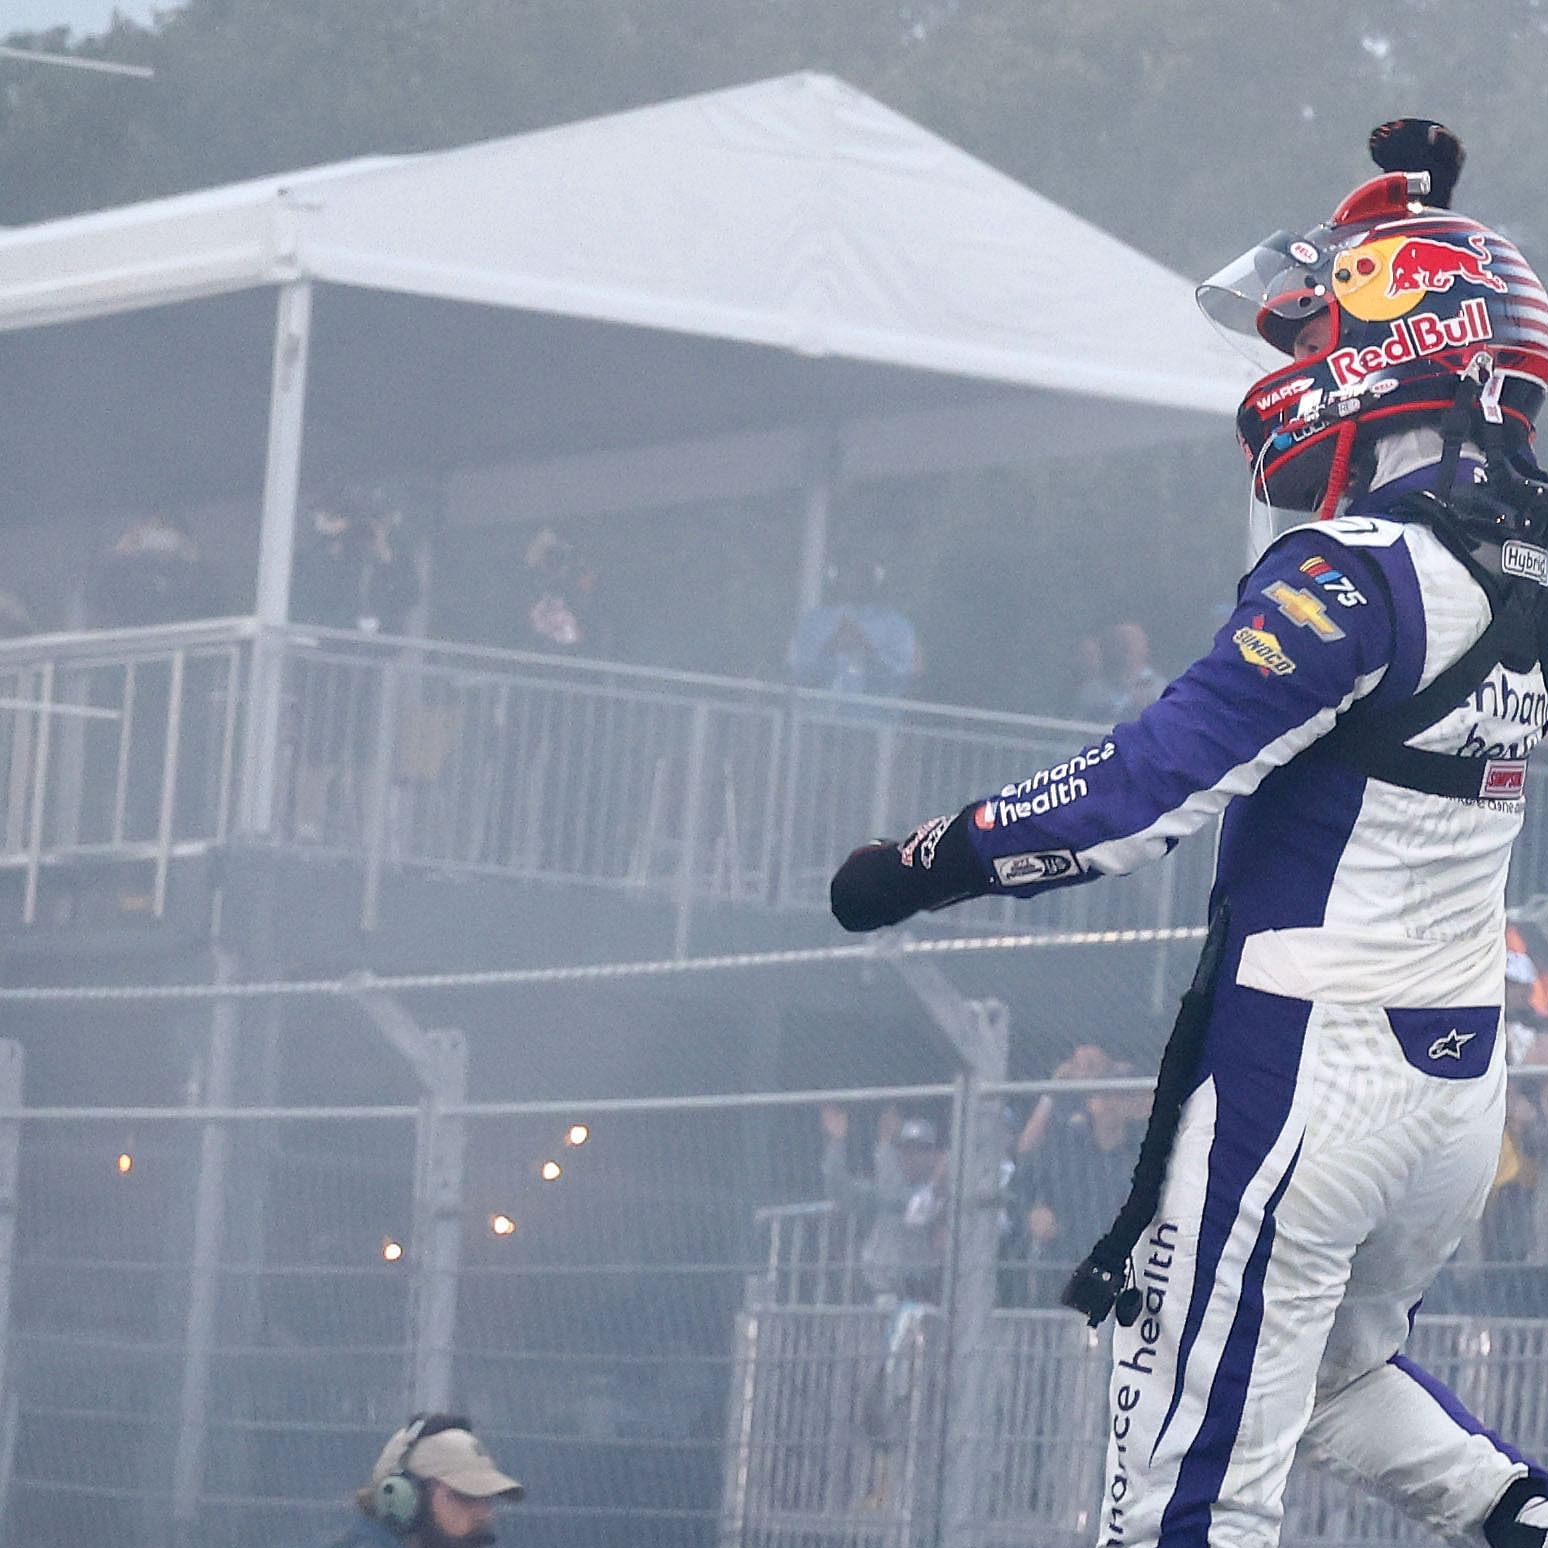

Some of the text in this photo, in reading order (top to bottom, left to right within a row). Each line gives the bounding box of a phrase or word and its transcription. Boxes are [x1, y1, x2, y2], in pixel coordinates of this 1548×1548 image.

[1327, 297, 1492, 390] Red Bull
[1507, 548, 1546, 576] Hybrid
[1324, 577, 1368, 607] 75
[1235, 630, 1291, 673] SUNOCO
[1001, 742, 1116, 798] enhance
[1000, 777, 1088, 827] health
[1118, 1221, 1178, 1374] health
